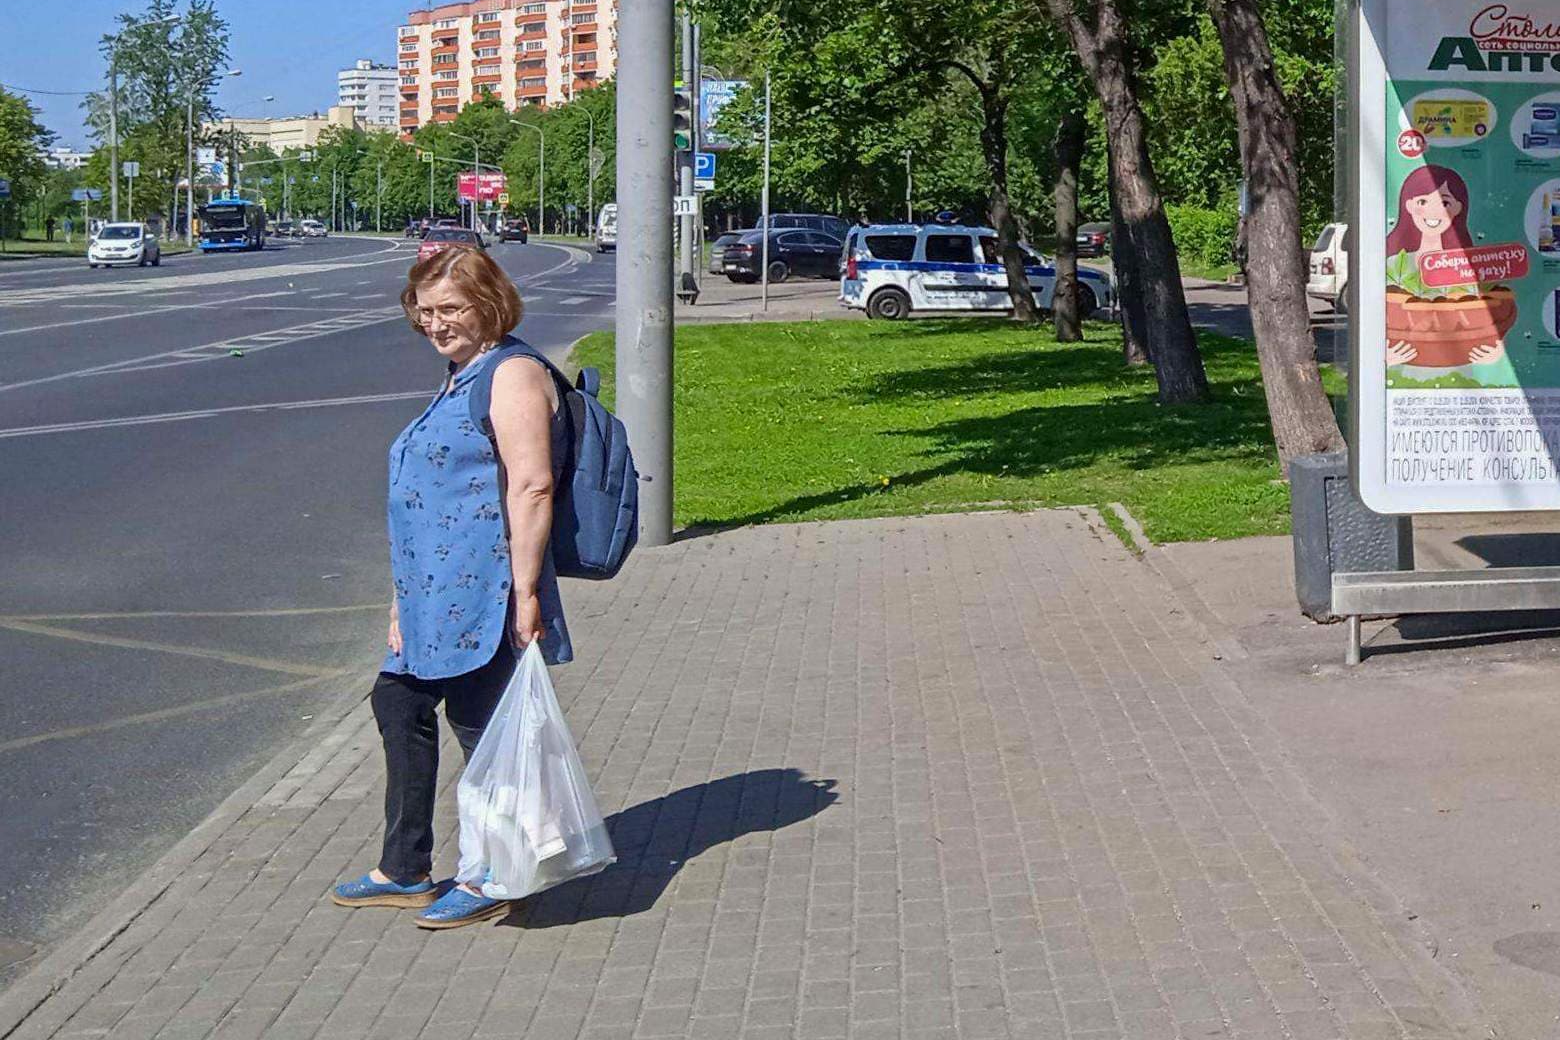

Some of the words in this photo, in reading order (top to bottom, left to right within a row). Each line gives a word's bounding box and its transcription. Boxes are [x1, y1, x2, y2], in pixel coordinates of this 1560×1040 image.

[1478, 41, 1504, 50] сеть
[674, 199, 690, 212] ОП
[1424, 255, 1469, 271] Собери
[1471, 248, 1525, 263] аптечку
[1460, 269, 1475, 278] на
[1479, 261, 1511, 280] дачу!
[1392, 430, 1458, 453] ИМЕЮТСЯ
[1392, 458, 1473, 482] ПОЛУЧЕНИЕ
